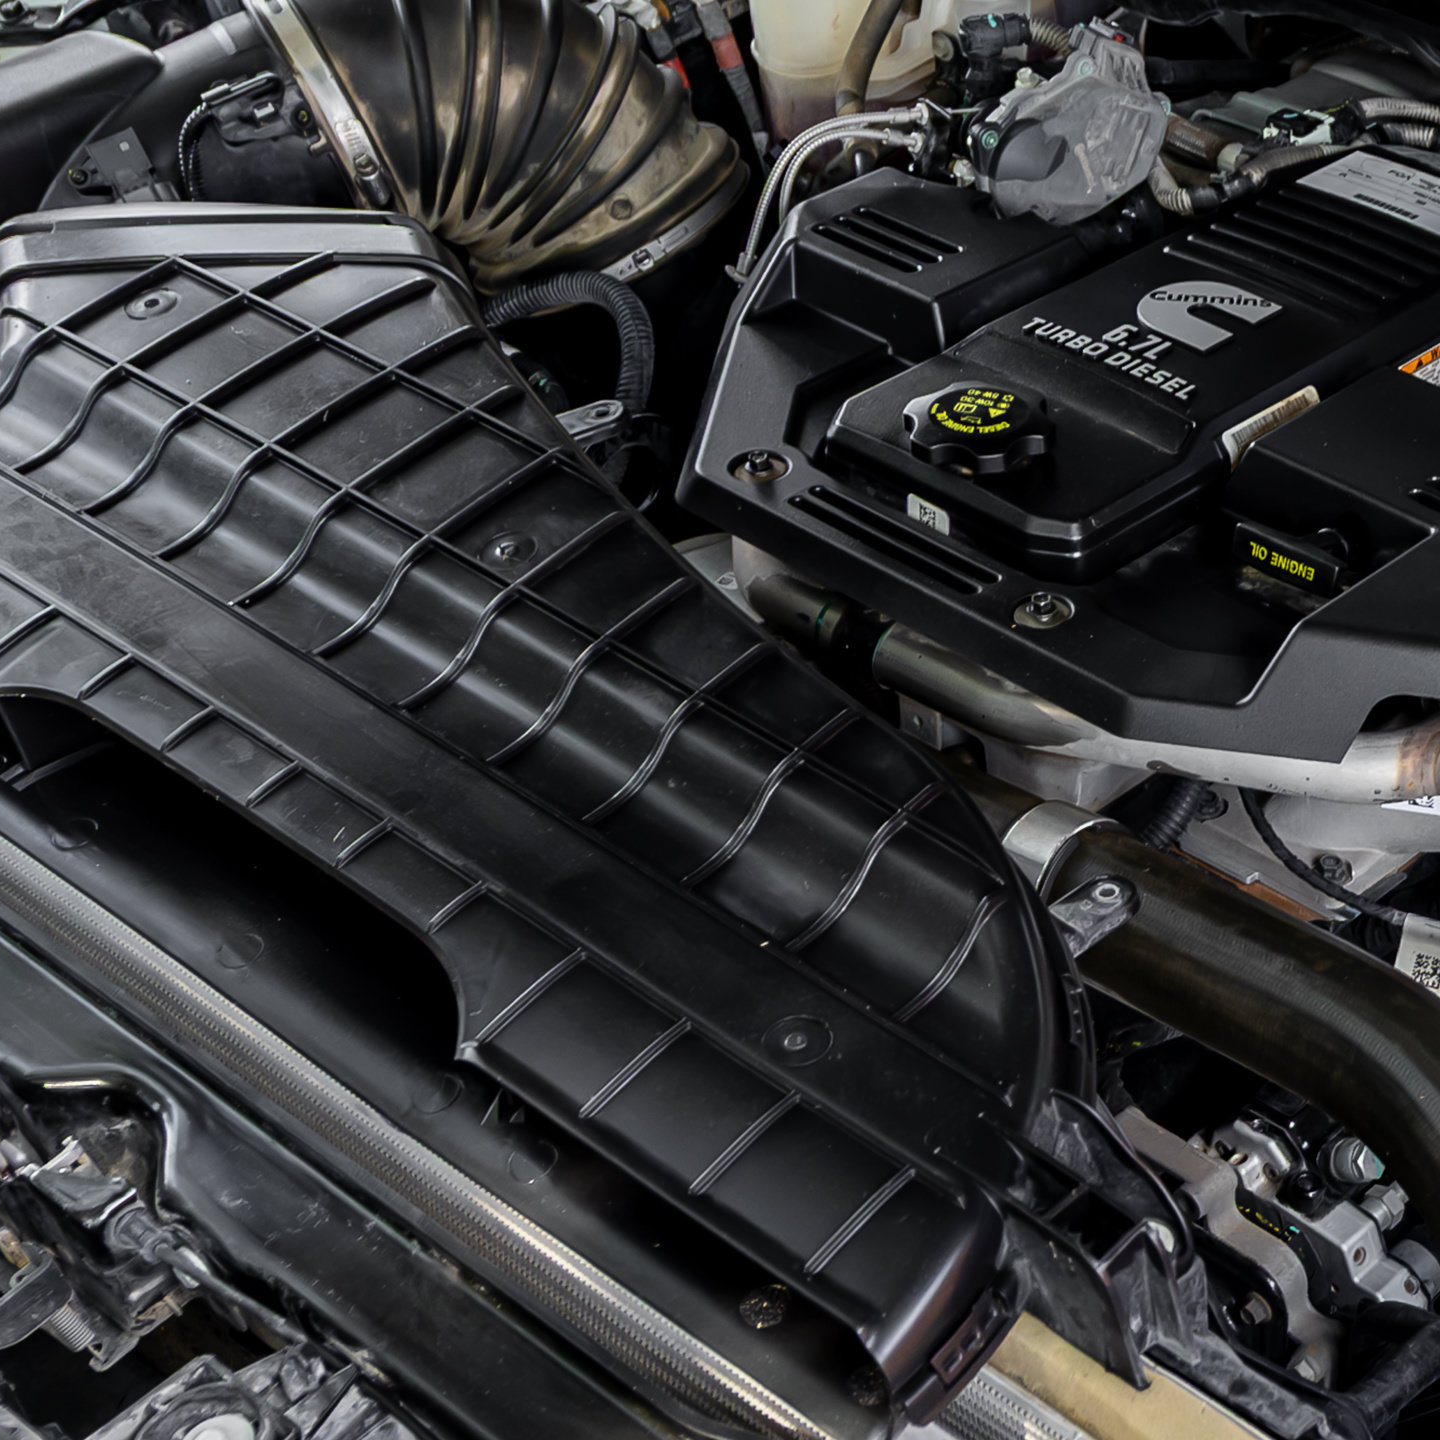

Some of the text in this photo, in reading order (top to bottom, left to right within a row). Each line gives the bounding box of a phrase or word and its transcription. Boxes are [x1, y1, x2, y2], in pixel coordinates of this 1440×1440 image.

[1022, 317, 1196, 401] TURBO DIESEL
[1102, 323, 1173, 361] 6.7L
[941, 418, 975, 434] ENGINE
[977, 421, 1010, 434] DIESEL
[1249, 541, 1315, 581] ENGINE OIL
